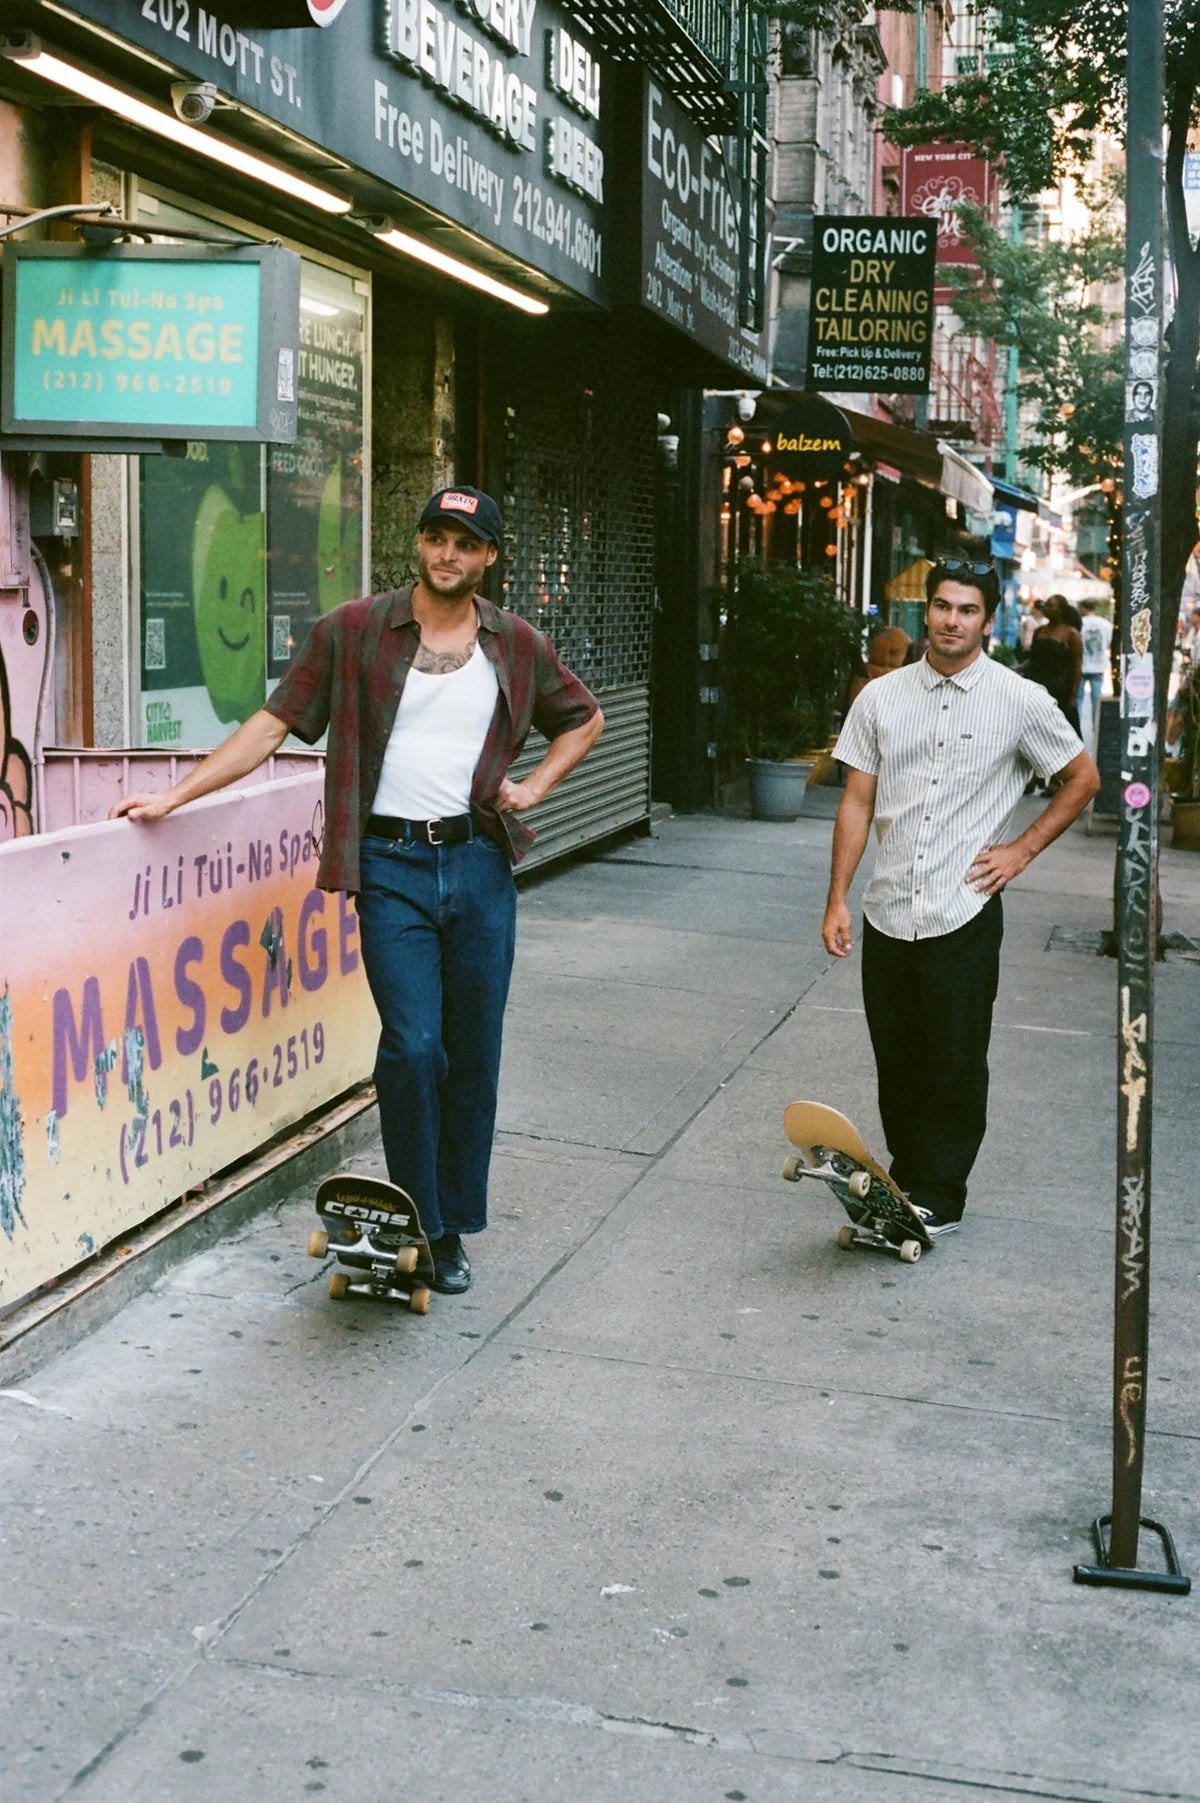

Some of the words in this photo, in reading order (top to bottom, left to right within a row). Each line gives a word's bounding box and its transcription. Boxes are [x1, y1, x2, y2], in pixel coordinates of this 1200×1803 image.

[141, 0, 190, 43] 202
[198, 8, 264, 84] MOTT
[270, 55, 302, 108] ST.
[471, 0, 537, 57] ERY
[557, 27, 600, 120] DELI
[393, 0, 537, 151] BEVERAGE
[556, 115, 604, 204] BEER
[374, 79, 423, 164] Free
[430, 118, 504, 226] Delivery
[935, 153, 957, 161] YORK
[958, 152, 975, 160] CIT
[822, 227, 927, 254] ORGANIC
[850, 259, 896, 283] DRY
[185, 290, 224, 314] Spa
[815, 288, 929, 313] CLEANING
[32, 318, 244, 363] MASSAGE
[815, 318, 927, 343] TAILORING
[861, 347, 873, 360] Up
[875, 348, 882, 359] &
[883, 348, 922, 362] Delivery
[43, 370, 103, 393] (212)
[777, 432, 841, 451] balzem
[147, 719, 183, 743] HARVEST
[129, 866, 151, 920] Ji
[162, 856, 184, 909] Li
[194, 840, 272, 898] Tui-Na
[279, 829, 313, 879] Spa
[52, 888, 360, 1120] MASSAGE
